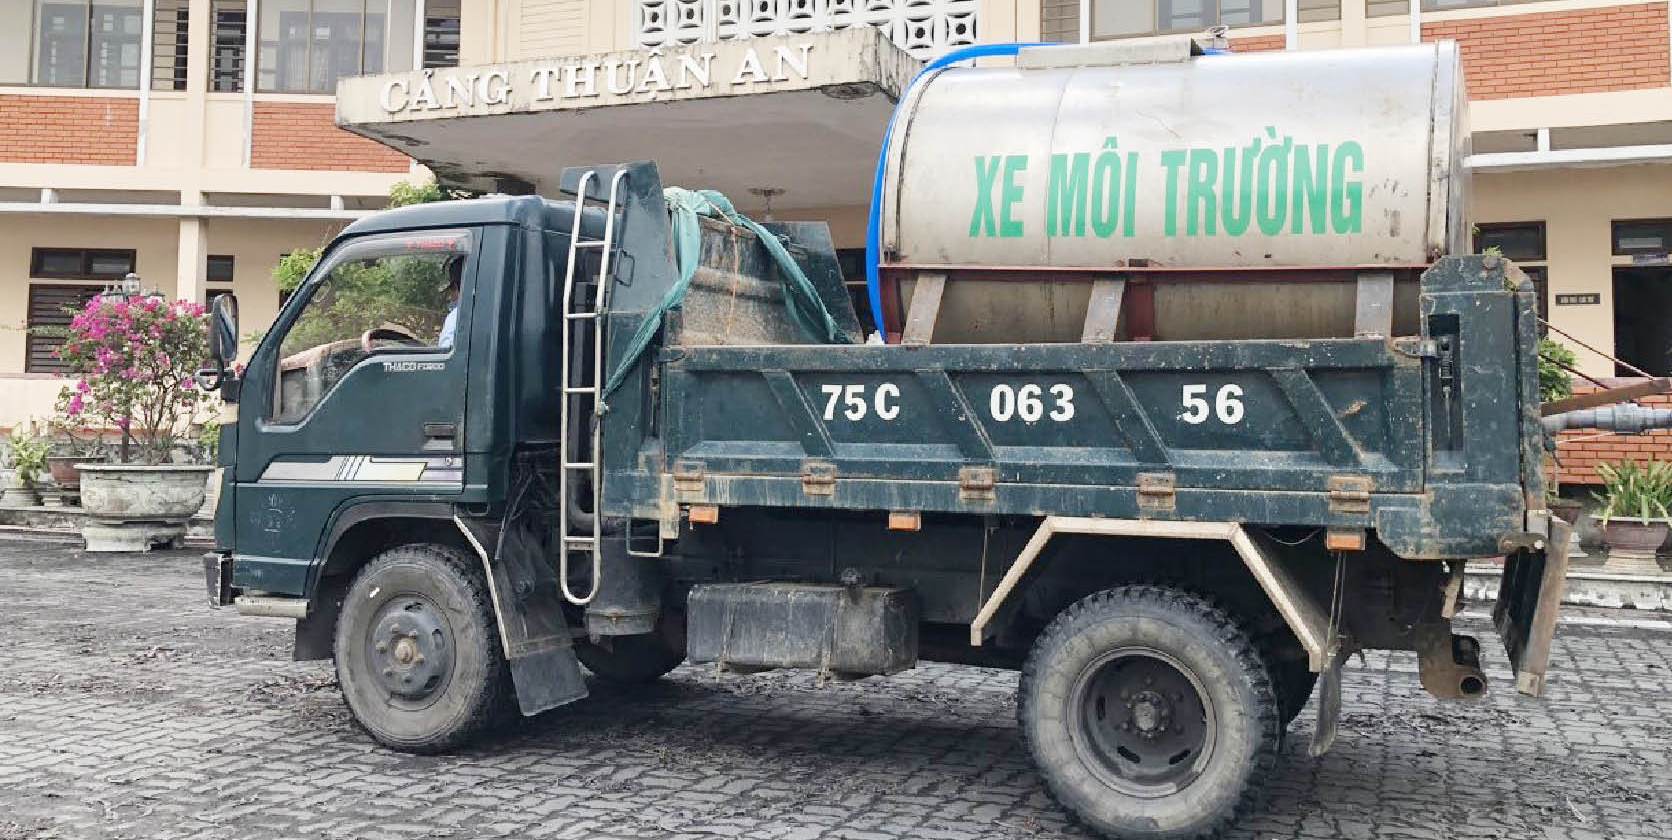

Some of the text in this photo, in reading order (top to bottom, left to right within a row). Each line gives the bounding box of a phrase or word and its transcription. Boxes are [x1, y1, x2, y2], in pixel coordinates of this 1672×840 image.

[382, 44, 814, 112] CẢNG THUẬN AN
[969, 126, 1364, 239] XE MÔI TRƯỜNG
[383, 361, 417, 372] THACO
[821, 382, 1245, 425] 75C 063 56
